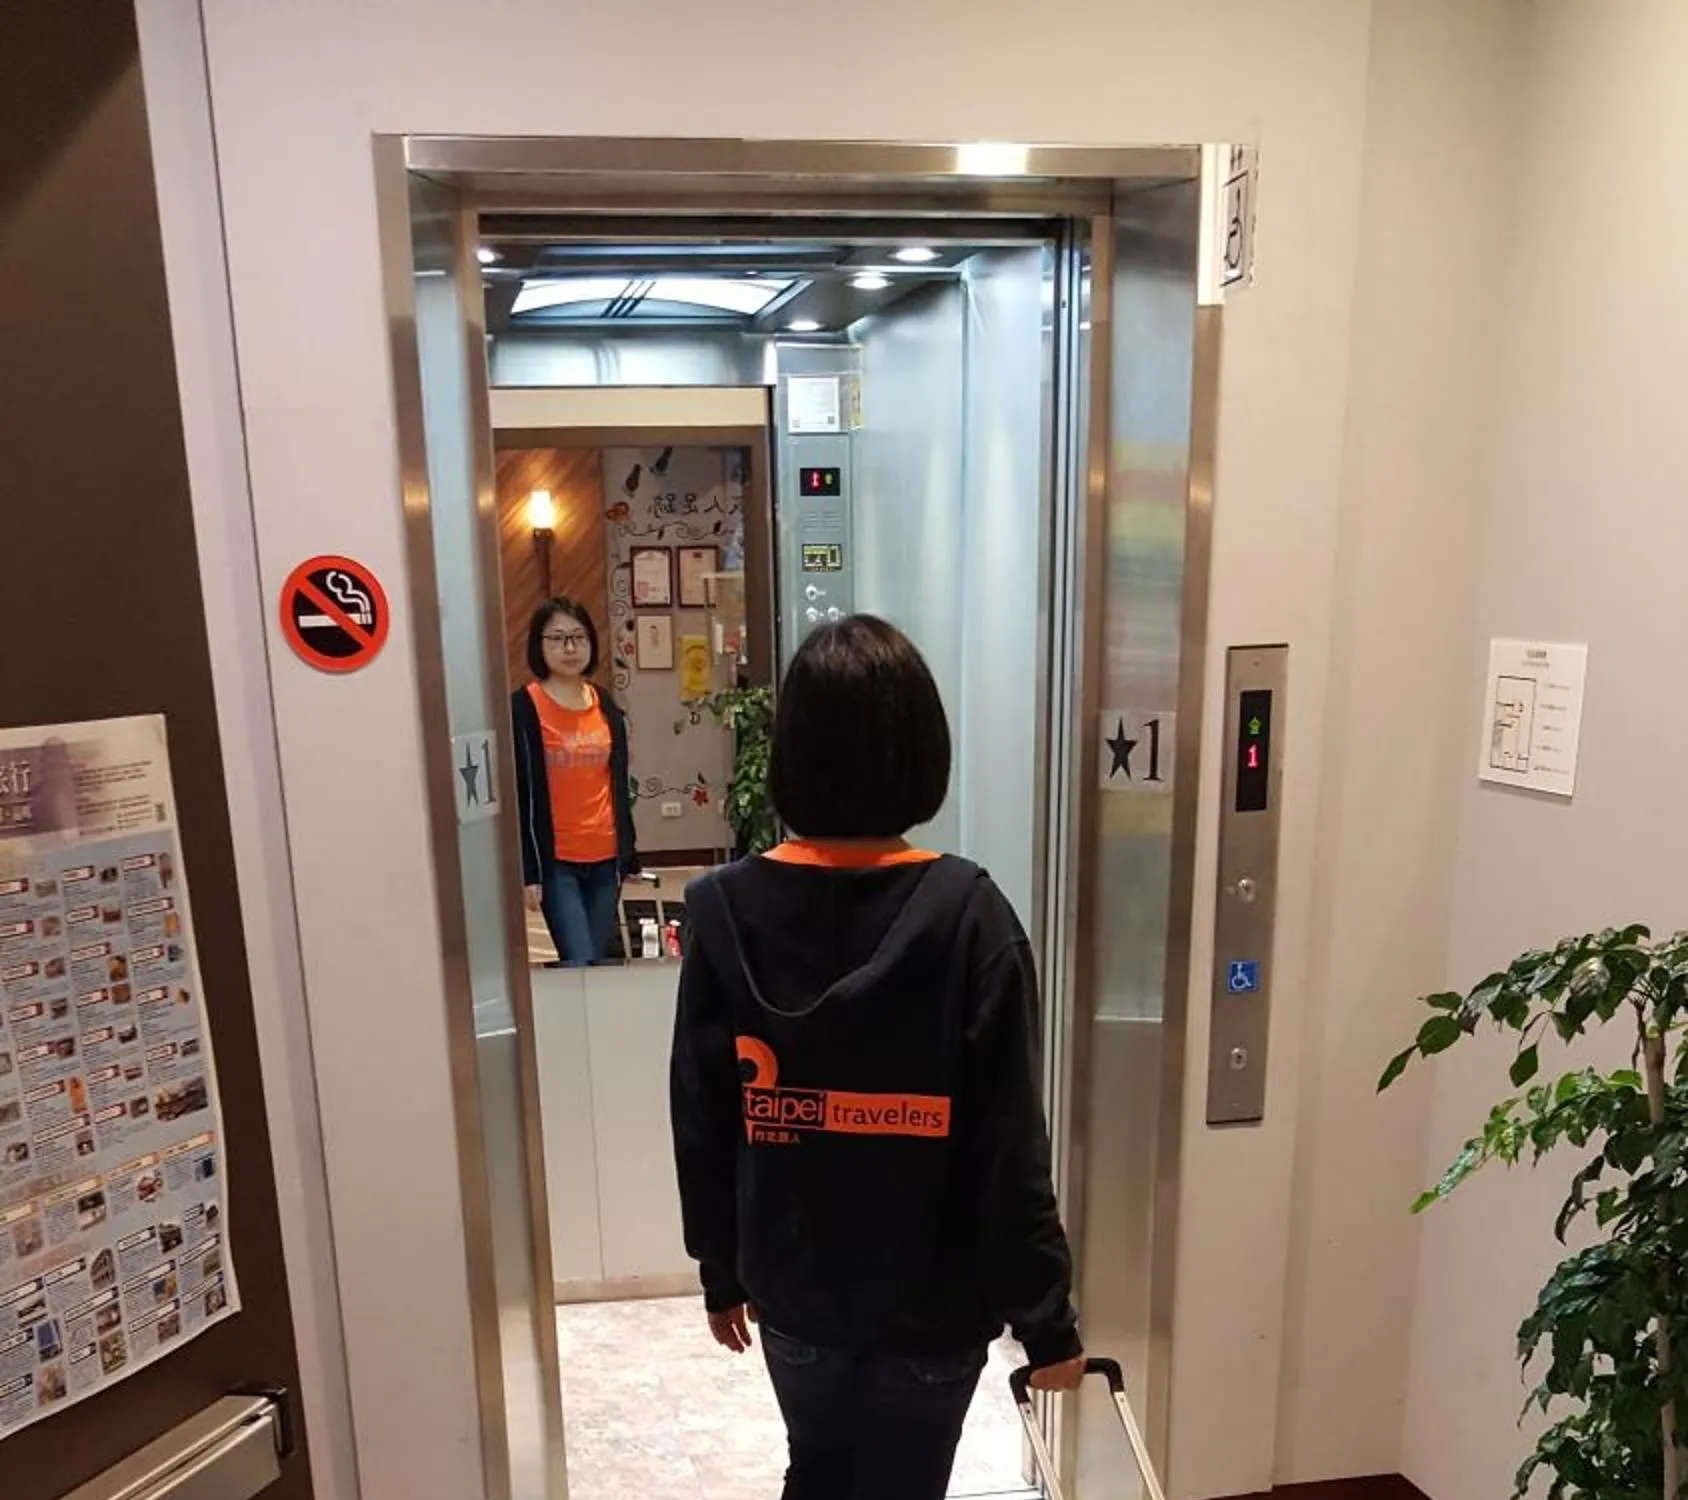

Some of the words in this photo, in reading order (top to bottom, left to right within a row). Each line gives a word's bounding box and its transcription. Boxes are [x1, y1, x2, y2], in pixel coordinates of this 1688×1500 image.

[481, 737, 497, 805] 1
[1141, 718, 1164, 782] 1
[1247, 743, 1259, 769] 1
[744, 1088, 825, 1123] taipei
[832, 1100, 943, 1129] travelers
